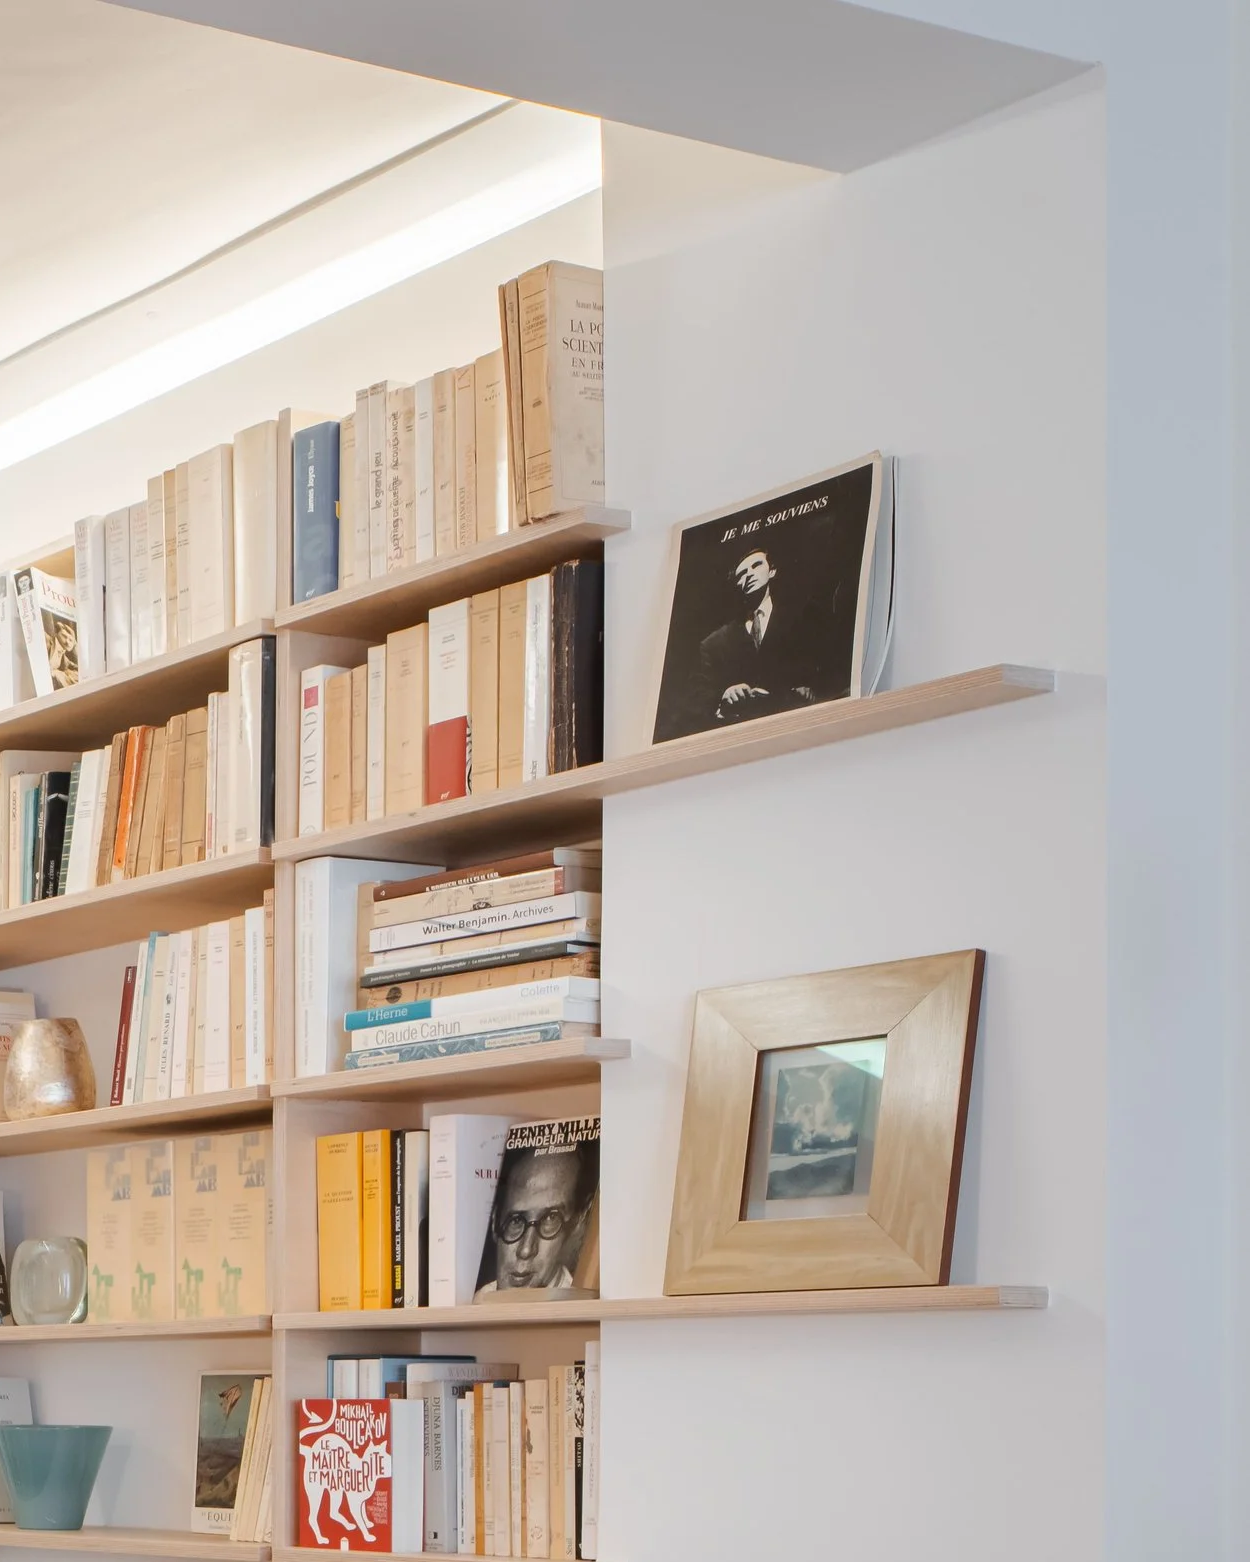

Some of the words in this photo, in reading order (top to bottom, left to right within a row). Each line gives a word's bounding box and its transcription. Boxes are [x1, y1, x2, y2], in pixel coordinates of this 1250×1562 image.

[570, 319, 584, 334] LA
[562, 336, 603, 356] SCIENT
[571, 357, 586, 369] EN
[373, 451, 383, 468] jeu
[370, 469, 384, 499] grand
[371, 499, 382, 510] le
[721, 527, 737, 543] JE
[741, 519, 761, 536] ME
[765, 495, 828, 527] SOUVIENS
[422, 922, 456, 936] Walter
[458, 912, 511, 929] Benjamin.
[512, 904, 554, 919] Archives
[520, 983, 560, 998] Colette
[367, 1006, 408, 1022] L'Herne
[162, 1012, 171, 1045] RENARD
[375, 1026, 418, 1045] Claude
[420, 1018, 461, 1037] Cahun
[160, 1049, 168, 1074] JULES
[507, 1123, 556, 1140] HENRY
[558, 1117, 601, 1134] MILLE
[506, 1133, 564, 1150] GRANDEUR
[533, 1147, 547, 1158] par
[474, 1168, 493, 1180] SUR
[566, 1368, 574, 1387] plein
[433, 1396, 441, 1429] DJUNA
[334, 1412, 387, 1449] BOULGAKOV
[320, 1439, 330, 1450] LE
[433, 1433, 442, 1471] BARNES
[308, 1471, 318, 1483] ET
[319, 1451, 385, 1493] MARGUERITE
